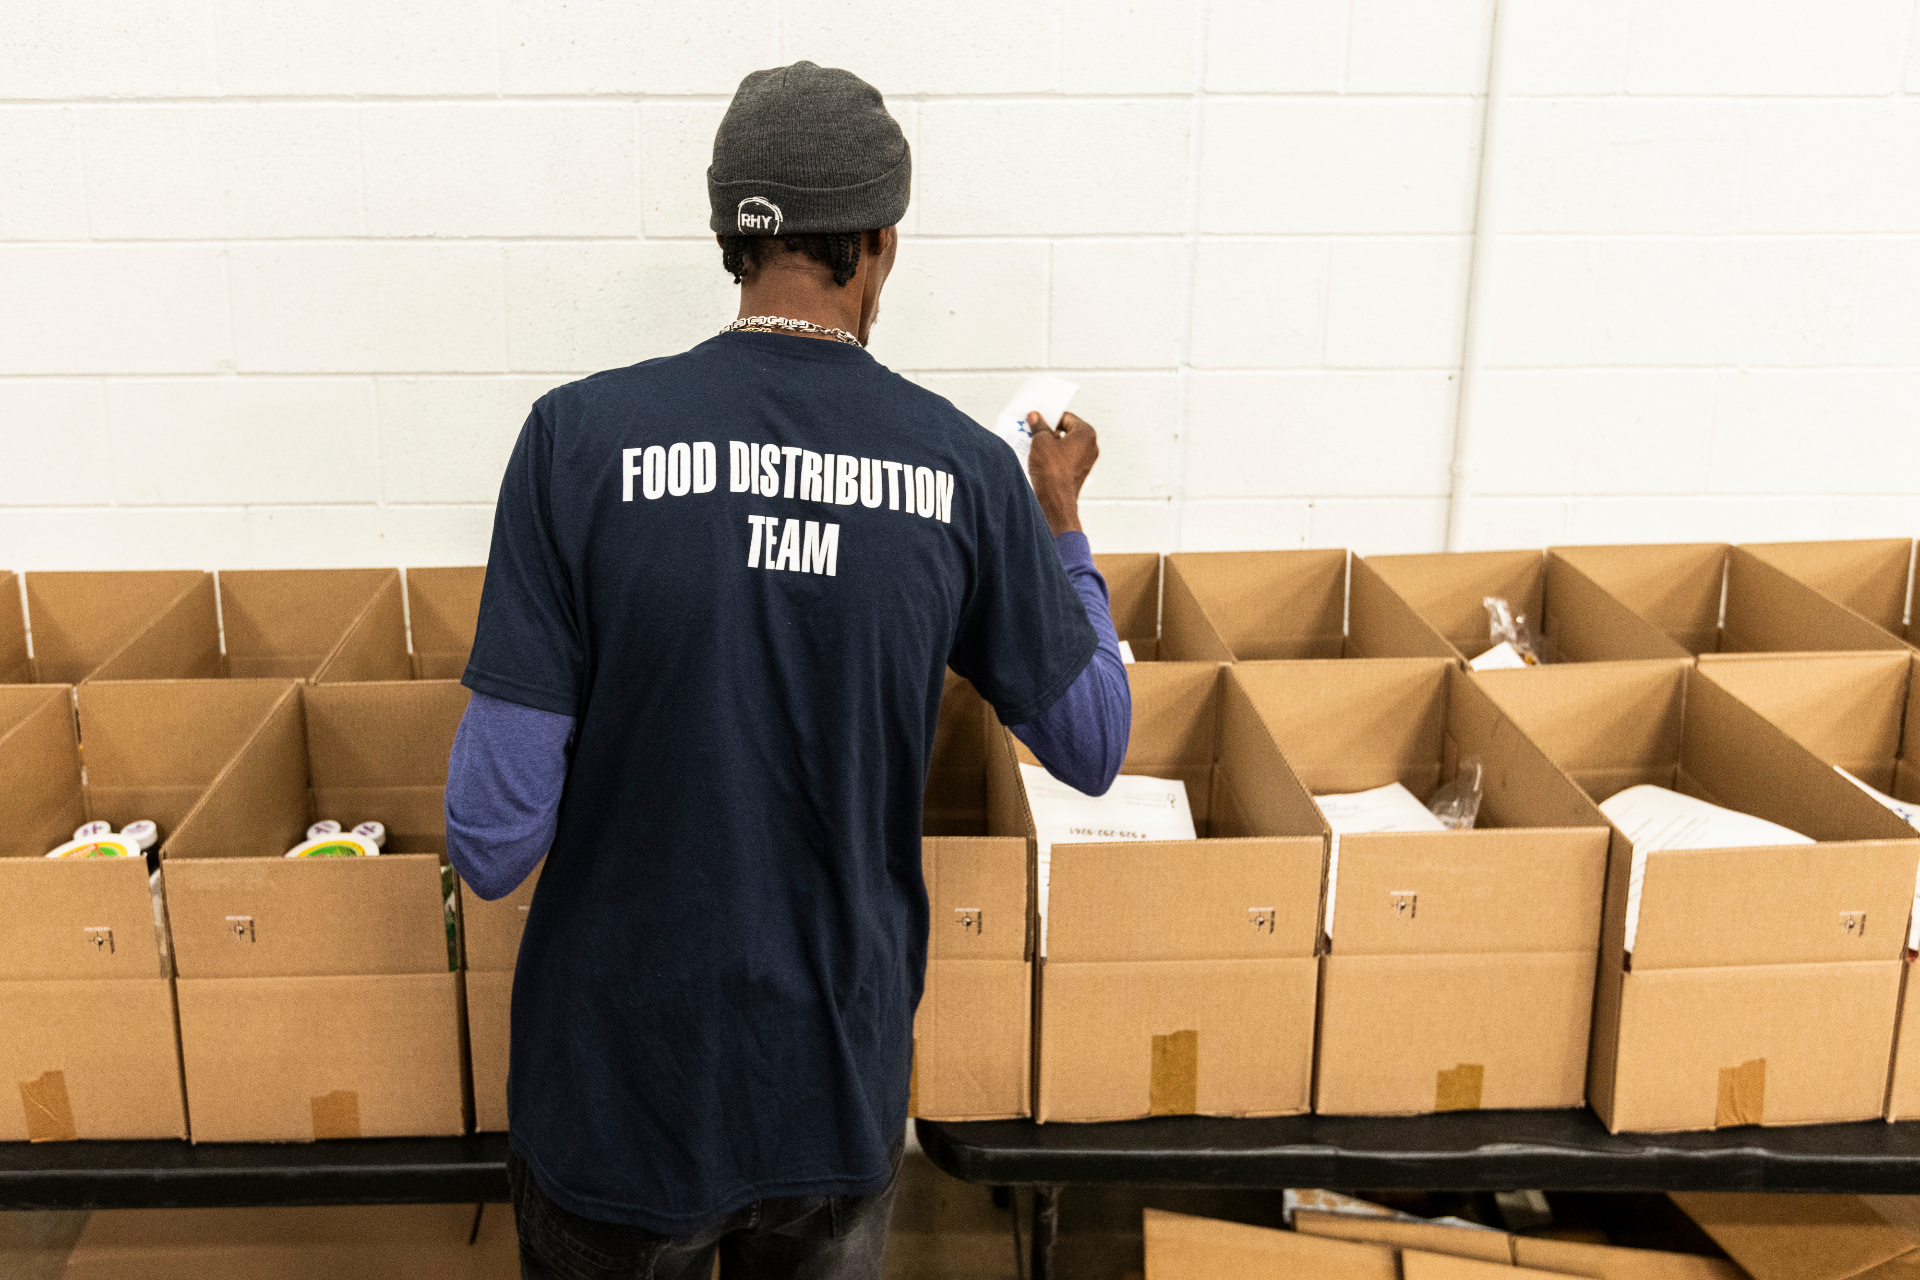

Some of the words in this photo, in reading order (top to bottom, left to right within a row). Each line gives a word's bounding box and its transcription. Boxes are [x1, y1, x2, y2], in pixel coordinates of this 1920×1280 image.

[741, 213, 773, 229] RHY
[622, 441, 717, 502] FOOD
[729, 440, 955, 524] DISTRIBUTION
[747, 514, 840, 577] TEAM
